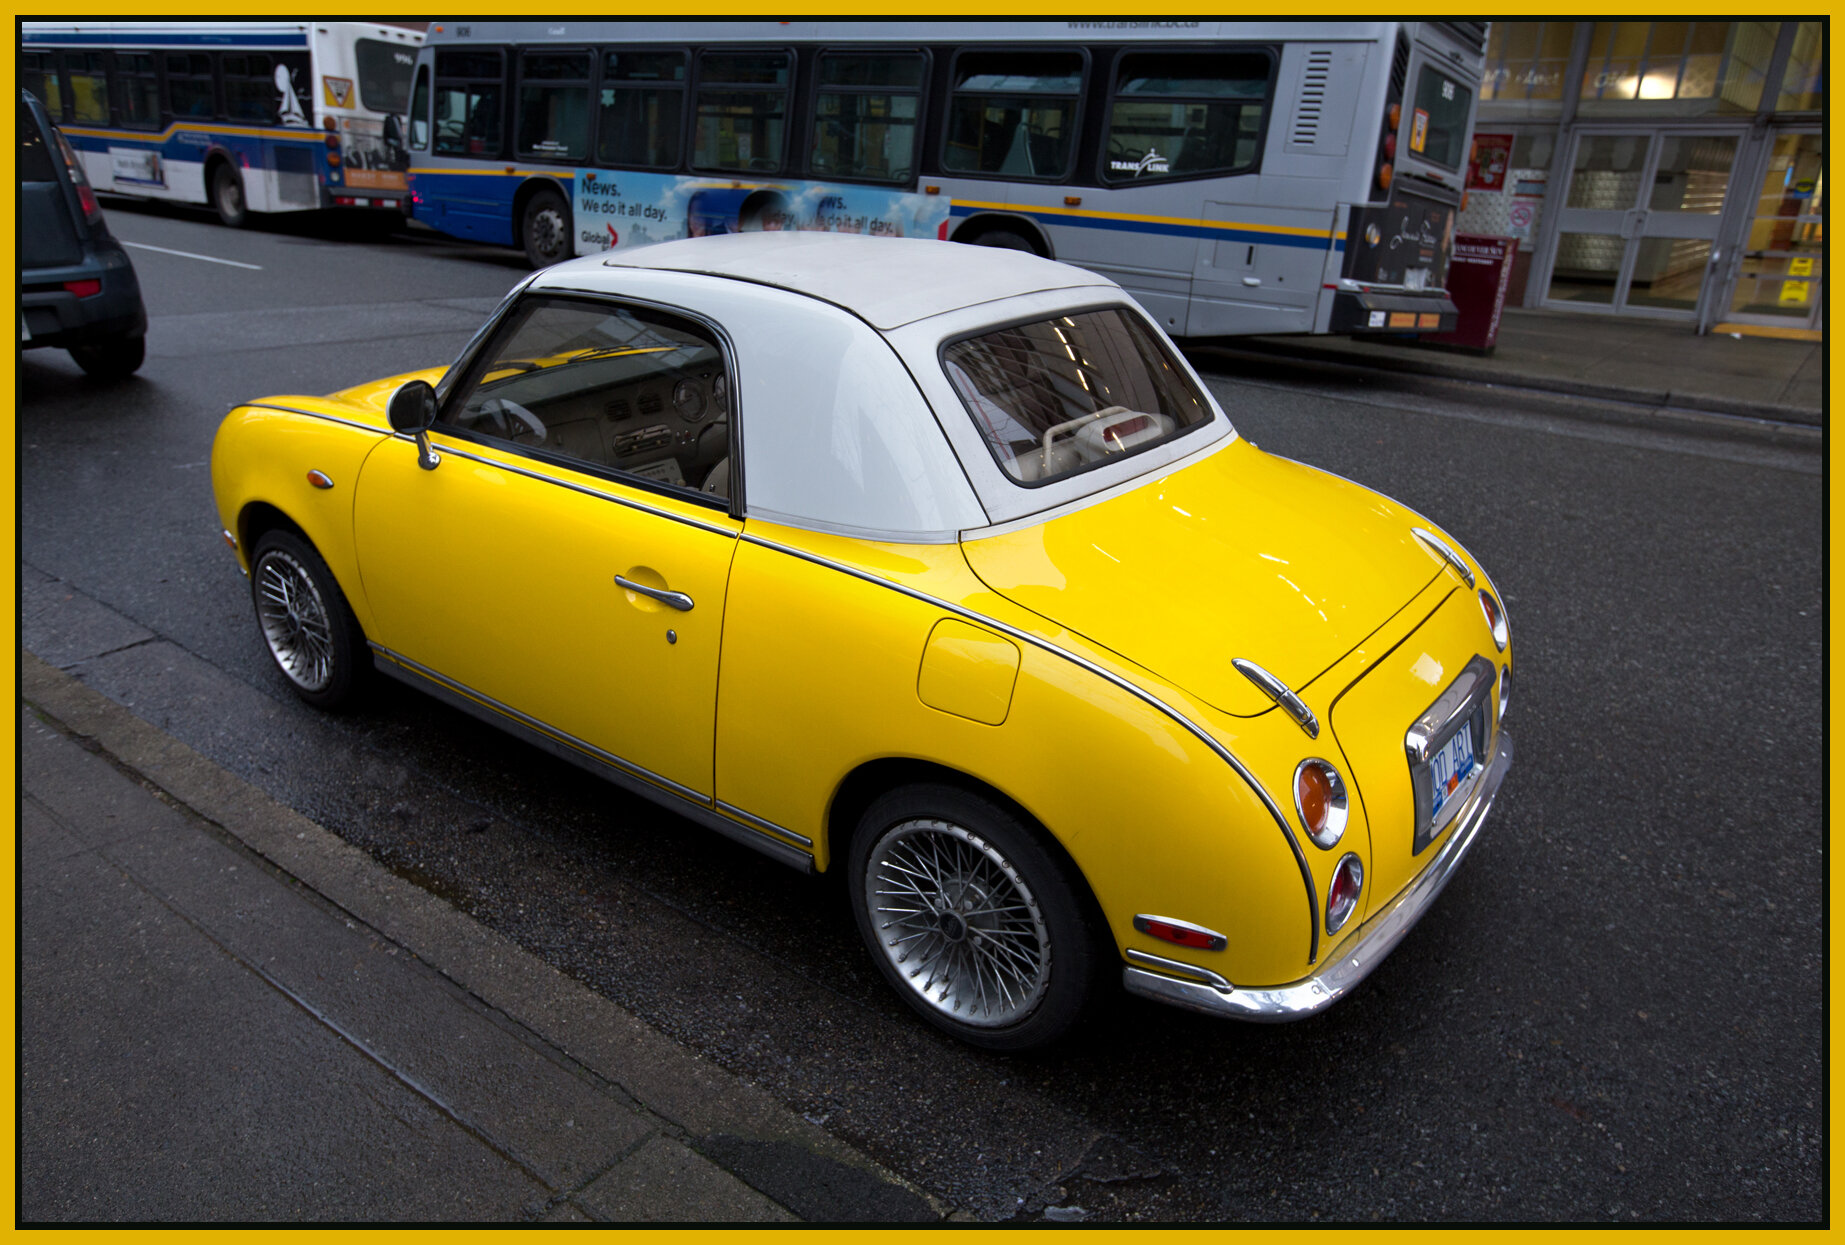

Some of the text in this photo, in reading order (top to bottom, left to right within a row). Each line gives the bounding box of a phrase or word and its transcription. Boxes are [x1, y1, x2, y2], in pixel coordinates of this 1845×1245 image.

[1146, 163, 1169, 173] LINK
[581, 178, 621, 197] News.
[581, 199, 668, 223] We do it all day.
[870, 217, 894, 234] day.
[581, 230, 610, 245] Global
[1452, 722, 1470, 774] ART
